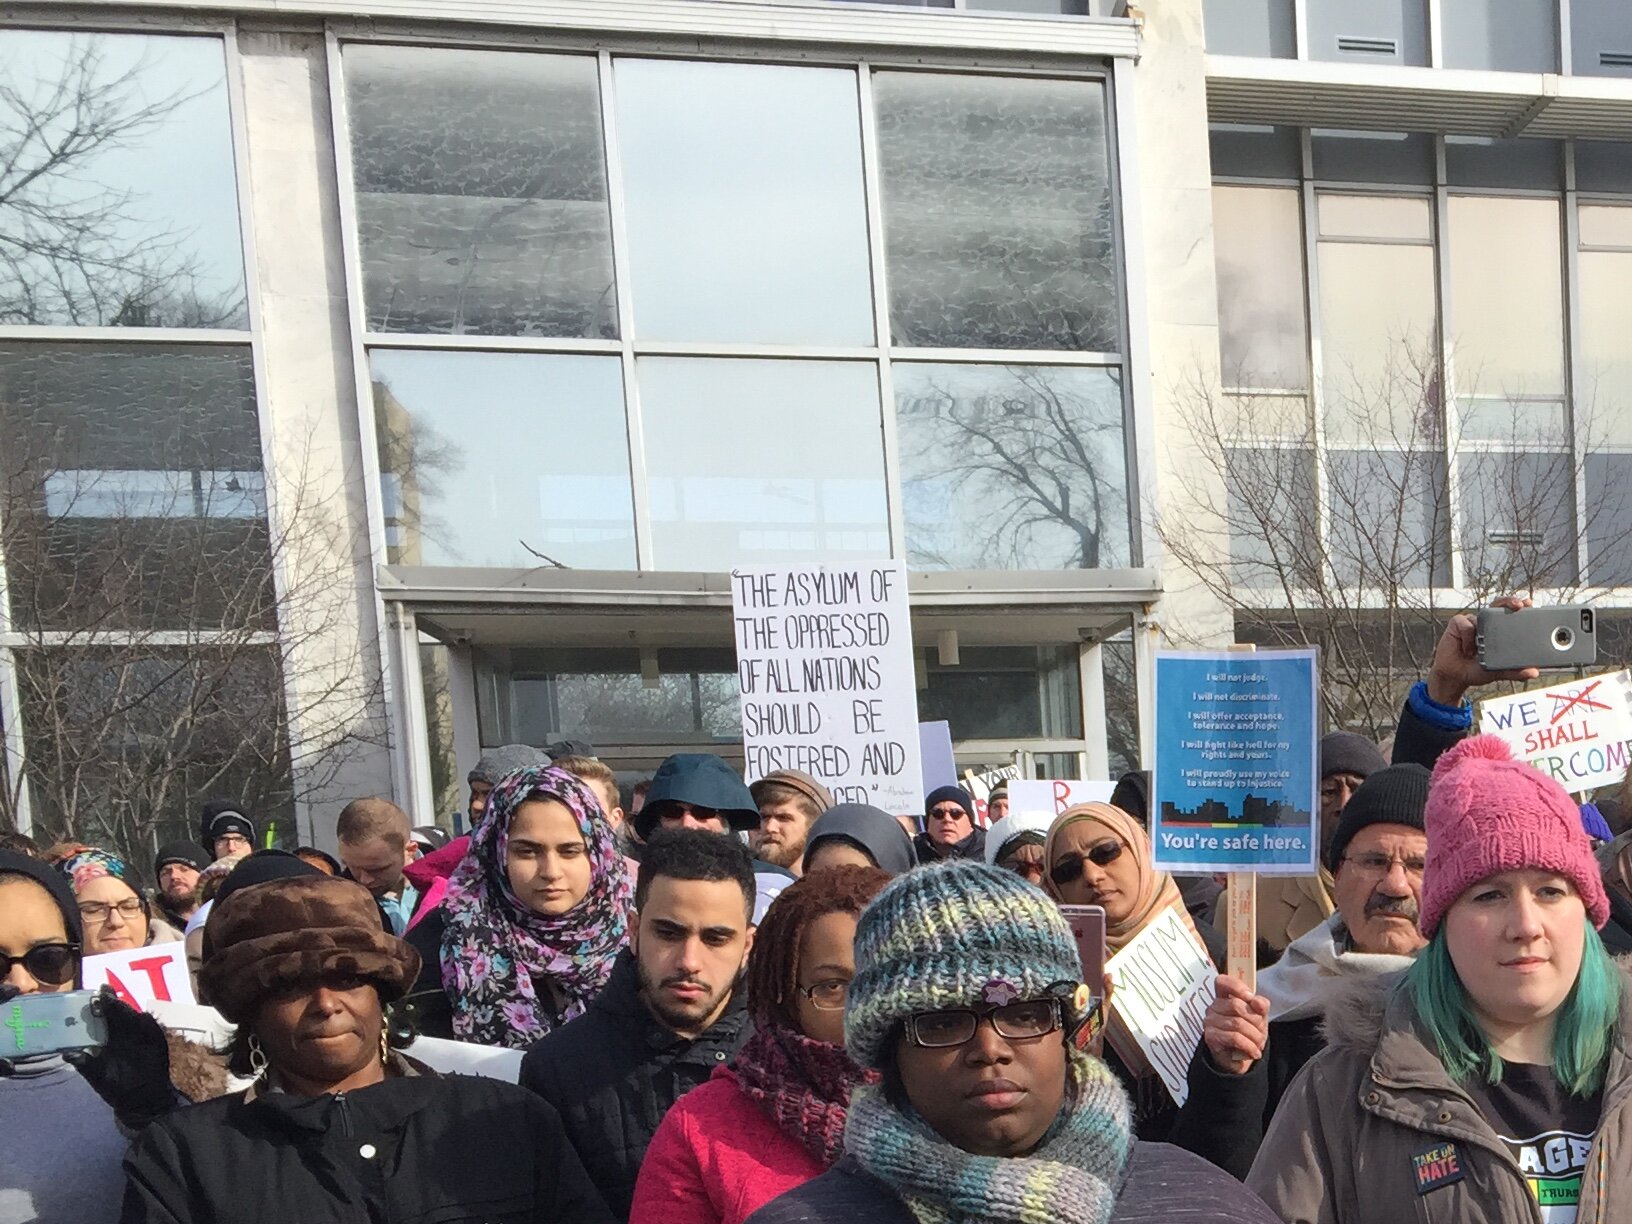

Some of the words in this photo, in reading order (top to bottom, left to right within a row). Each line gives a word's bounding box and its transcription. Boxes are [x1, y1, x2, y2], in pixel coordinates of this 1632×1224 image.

[784, 571, 861, 606] ASYLUM
[870, 570, 896, 603] OF
[736, 616, 778, 650] THE
[785, 612, 890, 650] OPPRESSED
[740, 659, 762, 694] OF
[766, 659, 799, 693] ALL
[802, 656, 881, 692] NATIONS
[745, 702, 822, 737] SHOULD
[853, 700, 886, 734] BE
[1488, 701, 1540, 730] WE
[1525, 720, 1598, 754] SHALL
[747, 746, 850, 779] FOSTERED
[861, 742, 906, 776] AND
[1162, 833, 1218, 849] You're
[1222, 834, 1258, 850] safe
[1264, 834, 1307, 850] here.
[1414, 1150, 1440, 1168] TAKE
[1441, 1144, 1456, 1158] ON
[1418, 1156, 1460, 1184] HATE
